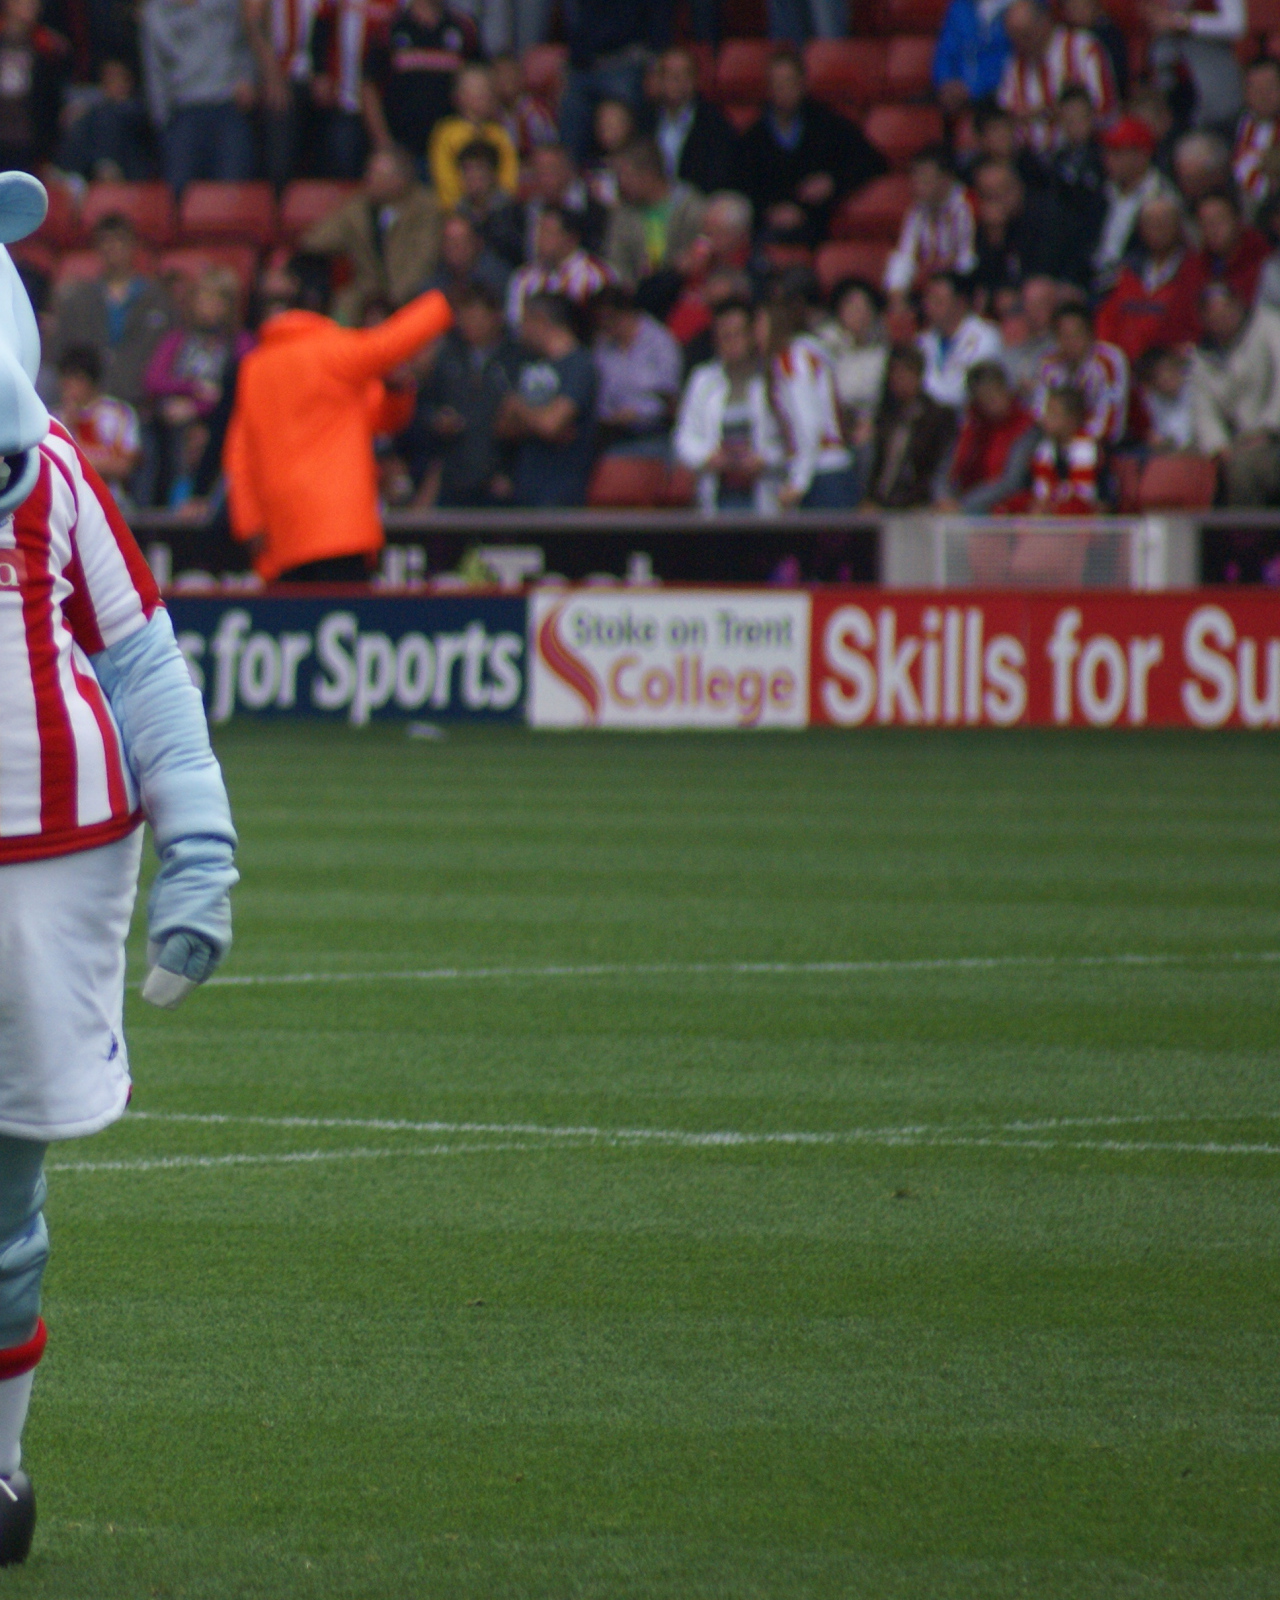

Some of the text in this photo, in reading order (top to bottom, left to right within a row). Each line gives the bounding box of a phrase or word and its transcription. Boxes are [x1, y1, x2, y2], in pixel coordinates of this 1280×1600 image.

[211, 610, 313, 723] for
[311, 611, 523, 727] Sports
[572, 609, 793, 646] Stoke on Trent
[824, 604, 1280, 728] Skills for Su
[609, 653, 795, 728] College
